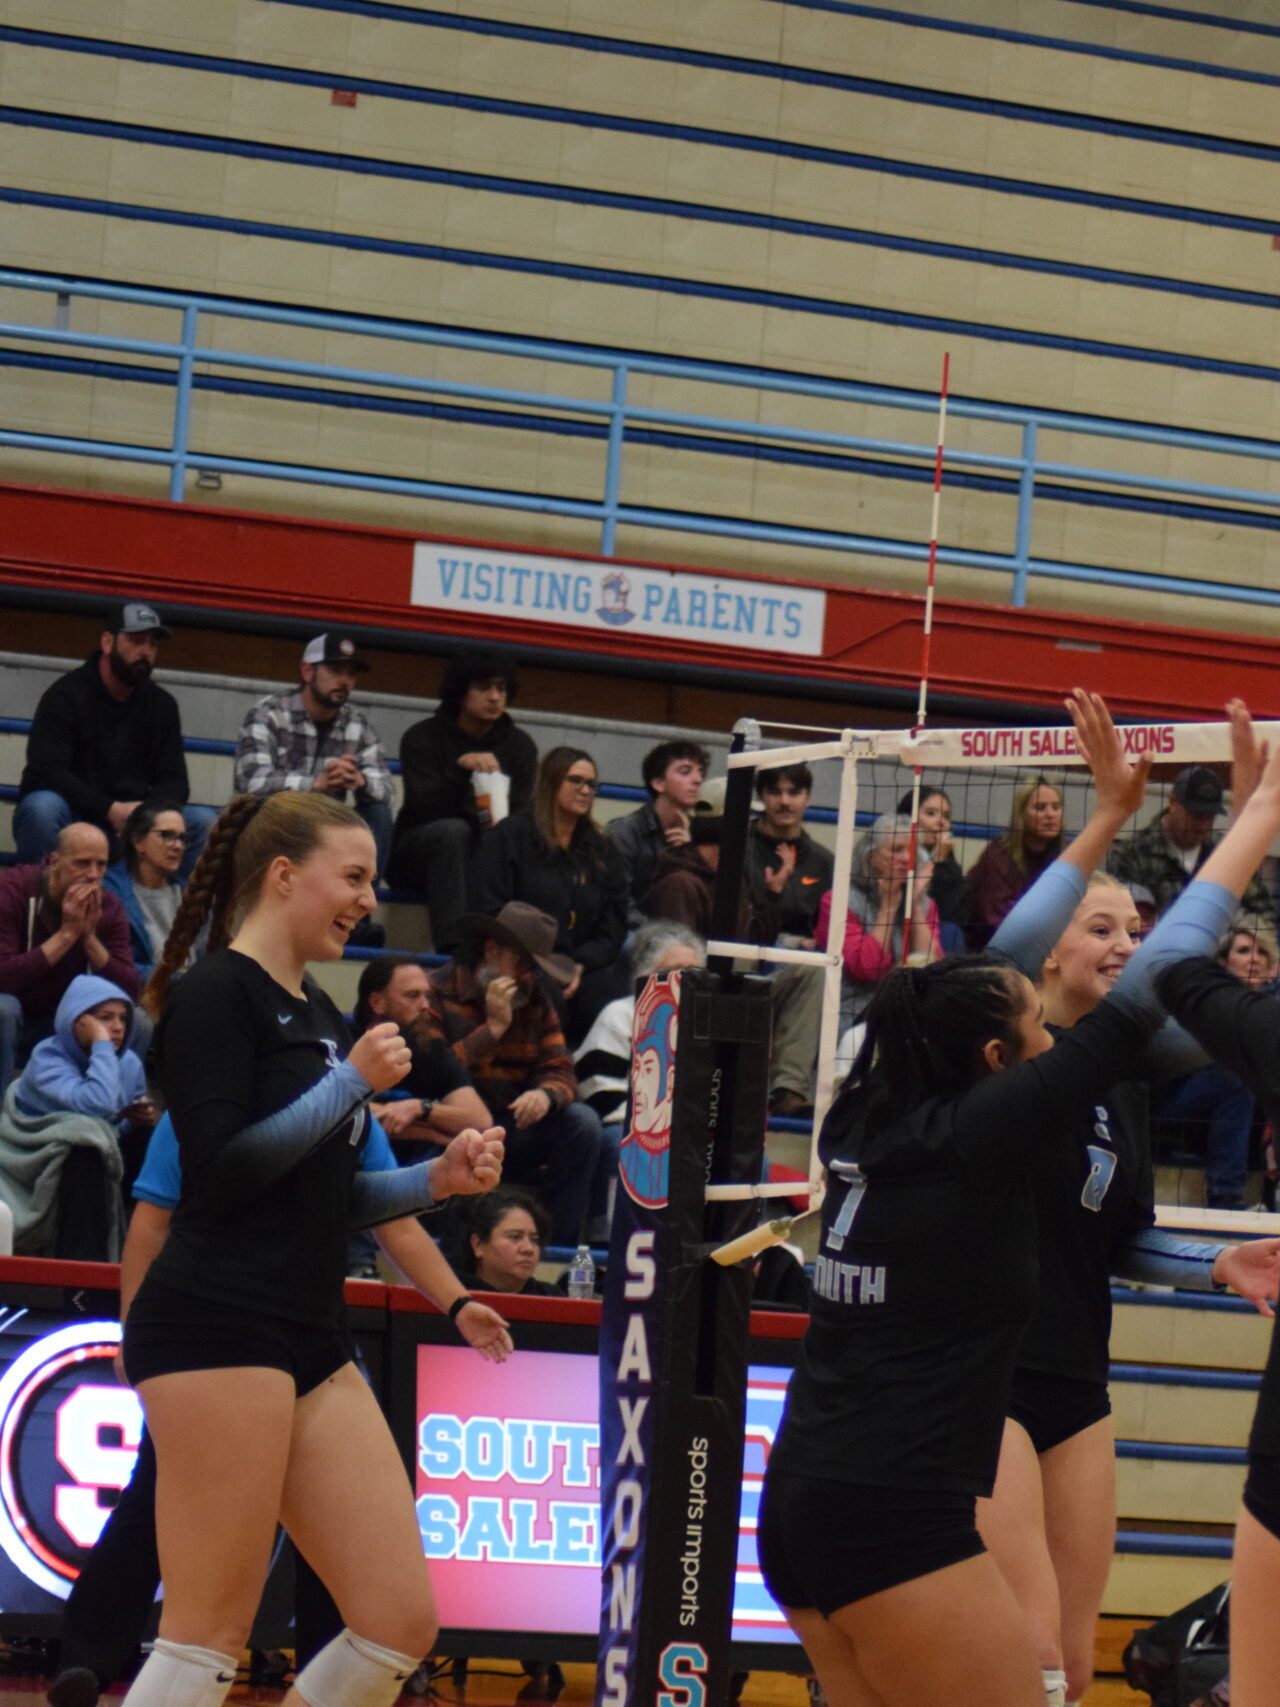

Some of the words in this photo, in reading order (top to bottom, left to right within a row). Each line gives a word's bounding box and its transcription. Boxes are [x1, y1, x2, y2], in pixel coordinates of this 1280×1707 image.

[437, 558, 592, 614] VISITING
[641, 583, 803, 640] PARENTS
[960, 730, 1024, 757] SOUTH
[1028, 729, 1082, 756] SALE
[1114, 726, 1176, 754] XONS
[825, 1158, 868, 1251] 7
[813, 1254, 887, 1304] OUTH
[419, 1412, 601, 1488] SOUT
[602, 1229, 657, 1707] SAXONS
[687, 1437, 709, 1520] sports
[416, 1493, 602, 1568] SALE
[679, 1524, 704, 1627] imports
[657, 1642, 709, 1707] S
